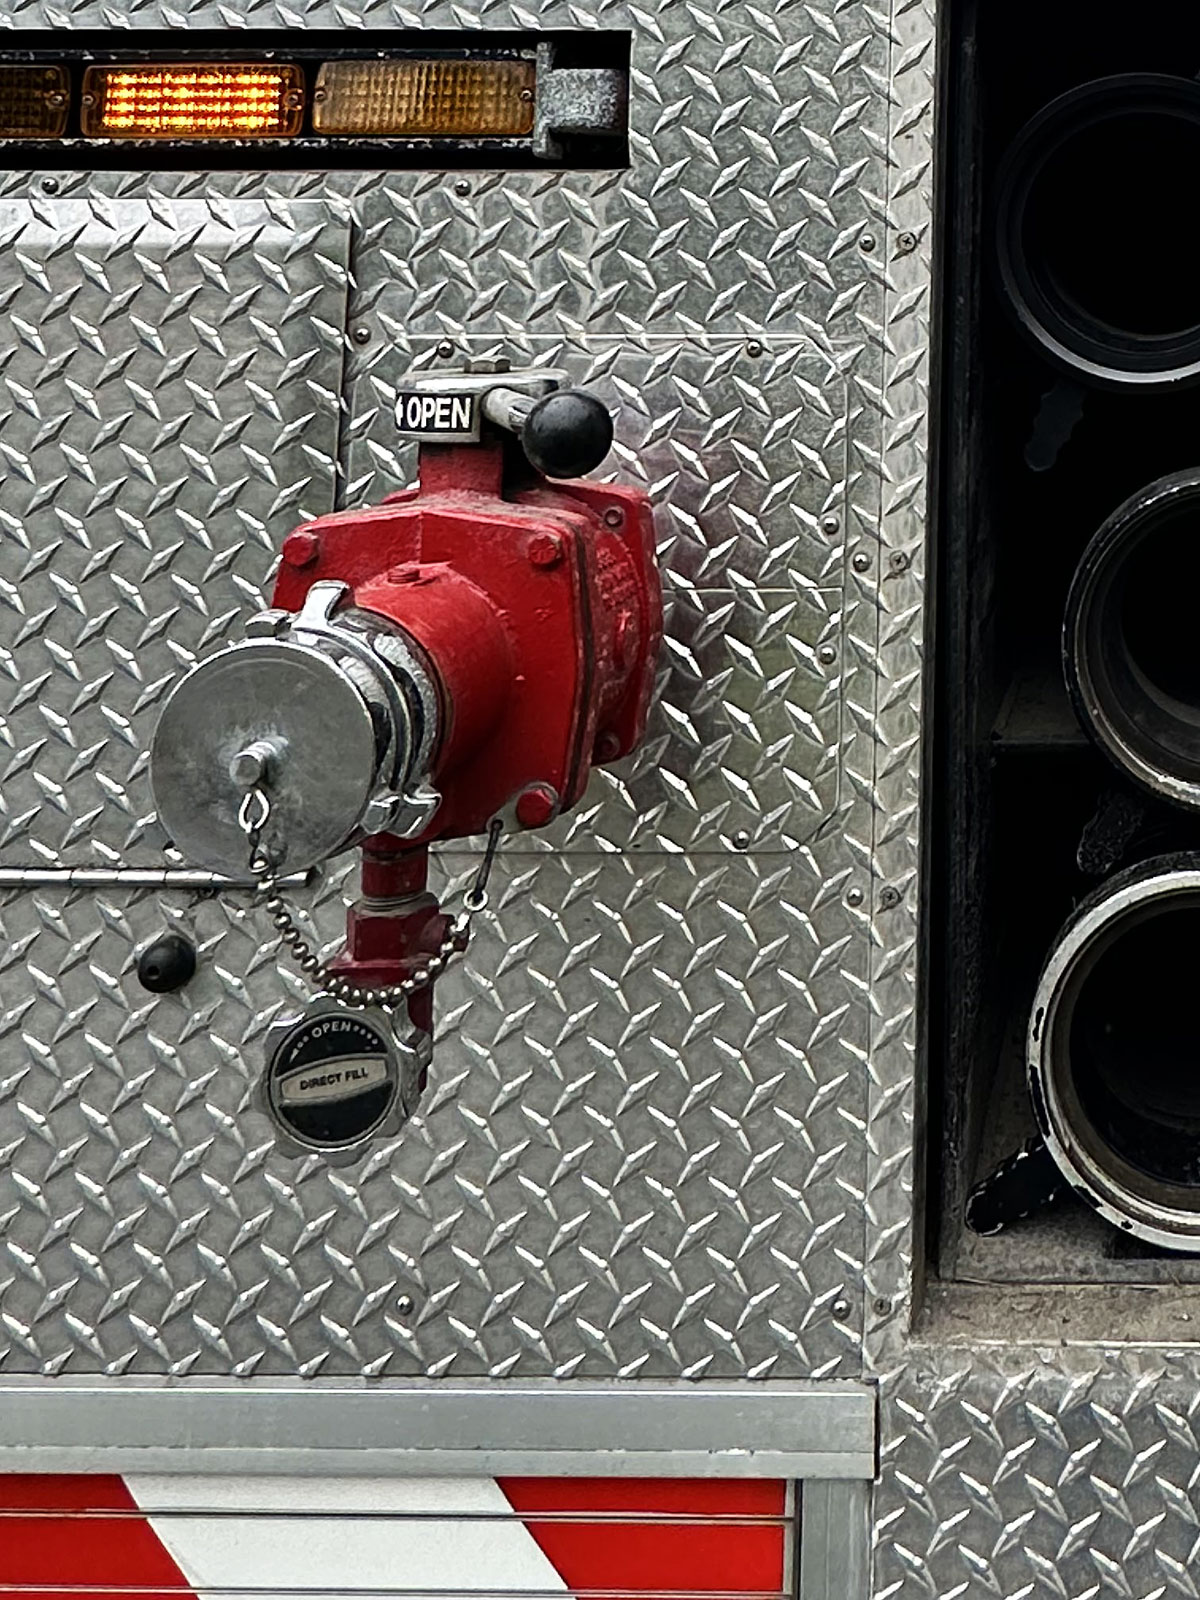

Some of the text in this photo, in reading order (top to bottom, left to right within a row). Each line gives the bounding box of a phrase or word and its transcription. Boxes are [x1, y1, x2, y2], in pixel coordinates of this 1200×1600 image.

[406, 396, 471, 429] OPEN
[311, 1021, 351, 1038] OPEN
[300, 1067, 369, 1090] DIRECT FILL
